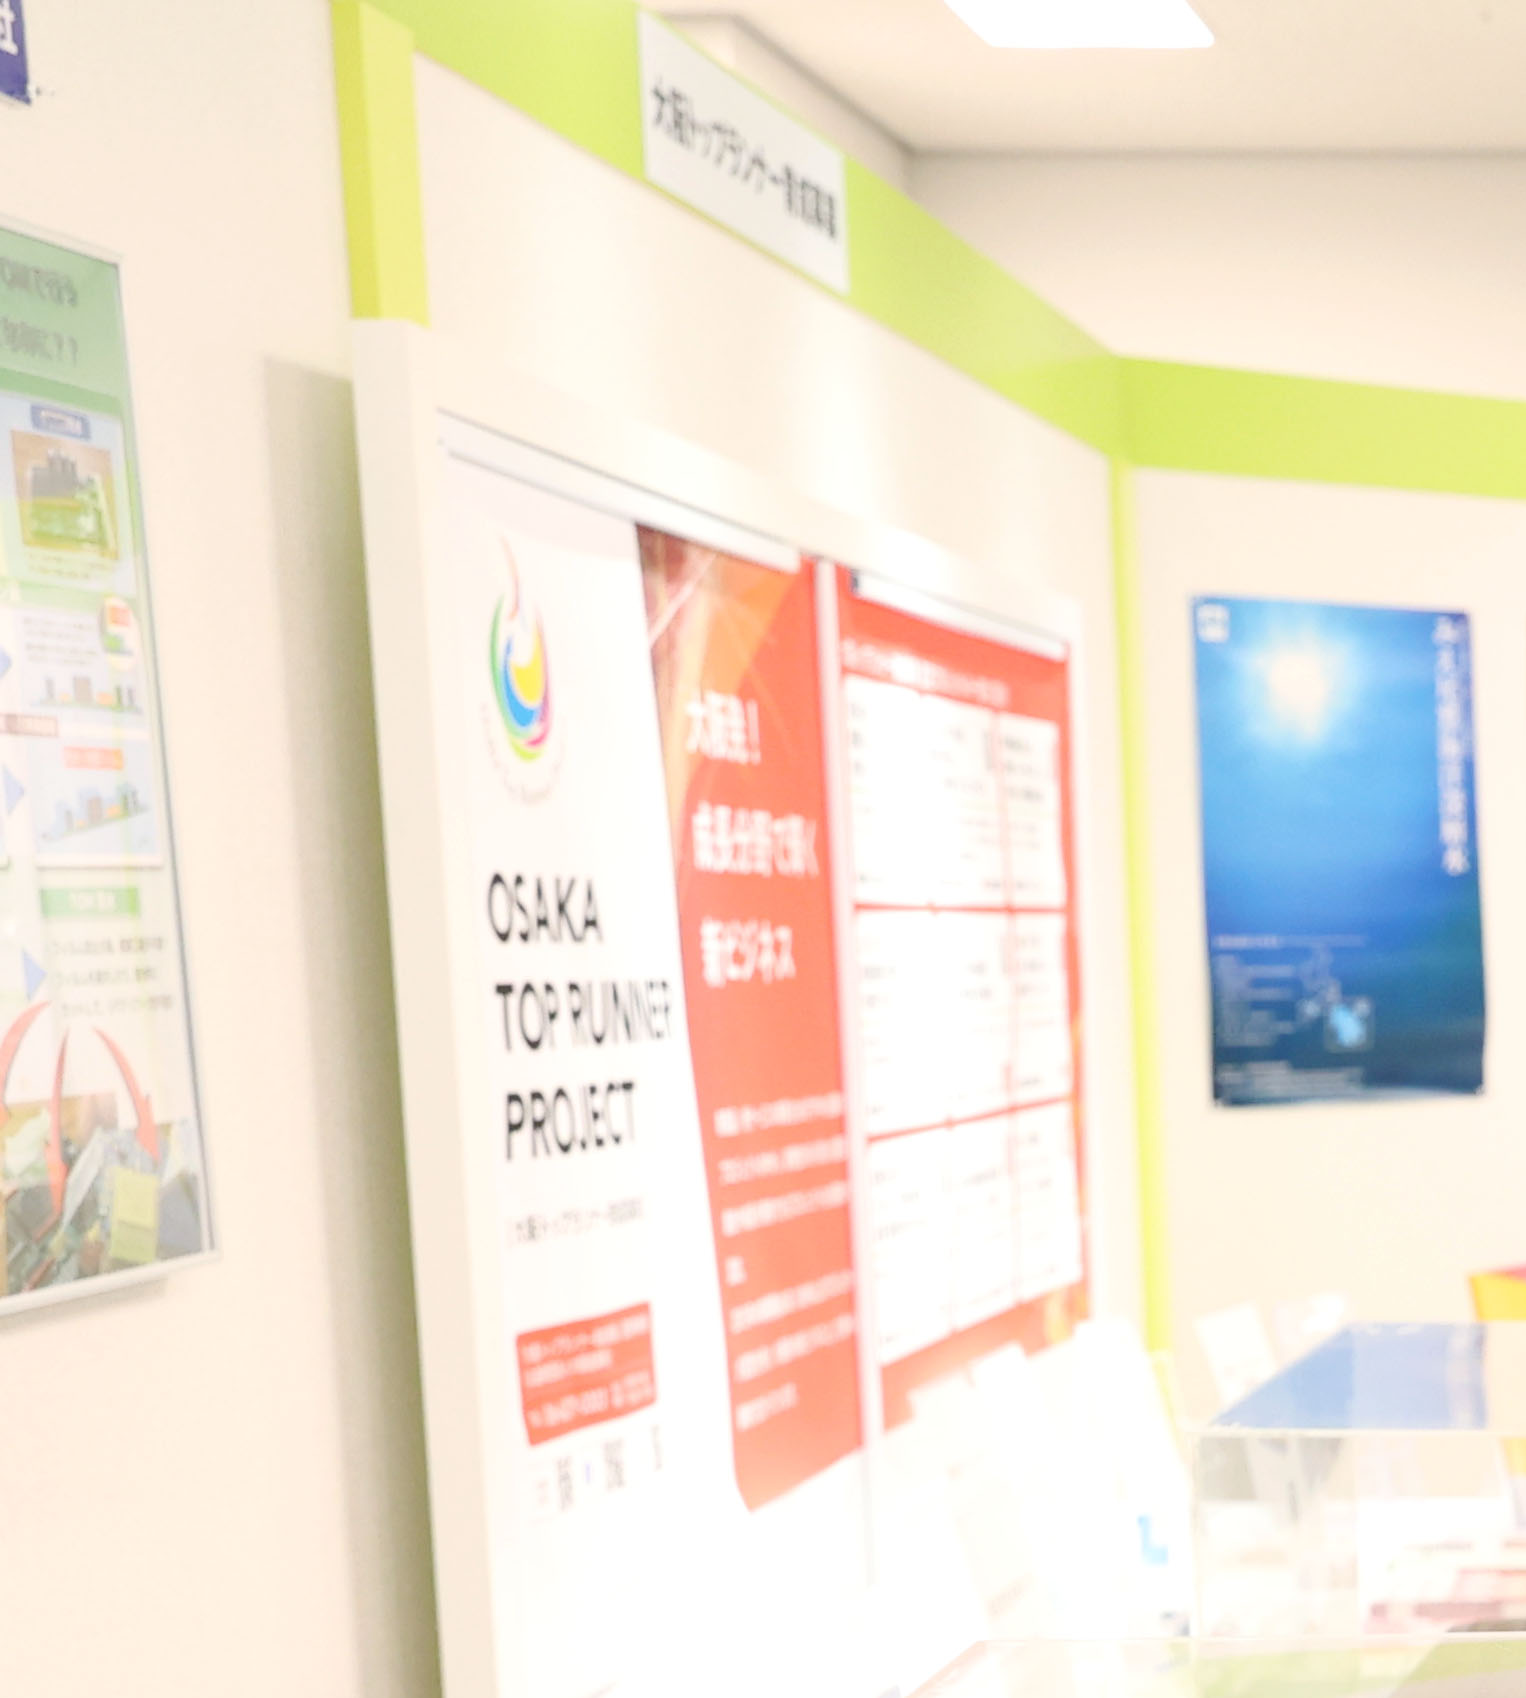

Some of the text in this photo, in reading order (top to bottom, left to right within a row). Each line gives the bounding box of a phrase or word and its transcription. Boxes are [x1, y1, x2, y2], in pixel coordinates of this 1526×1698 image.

[488, 873, 603, 943] OSAKA
[495, 978, 671, 1052] TOP RUNNER
[506, 1081, 635, 1162] PROJECT
